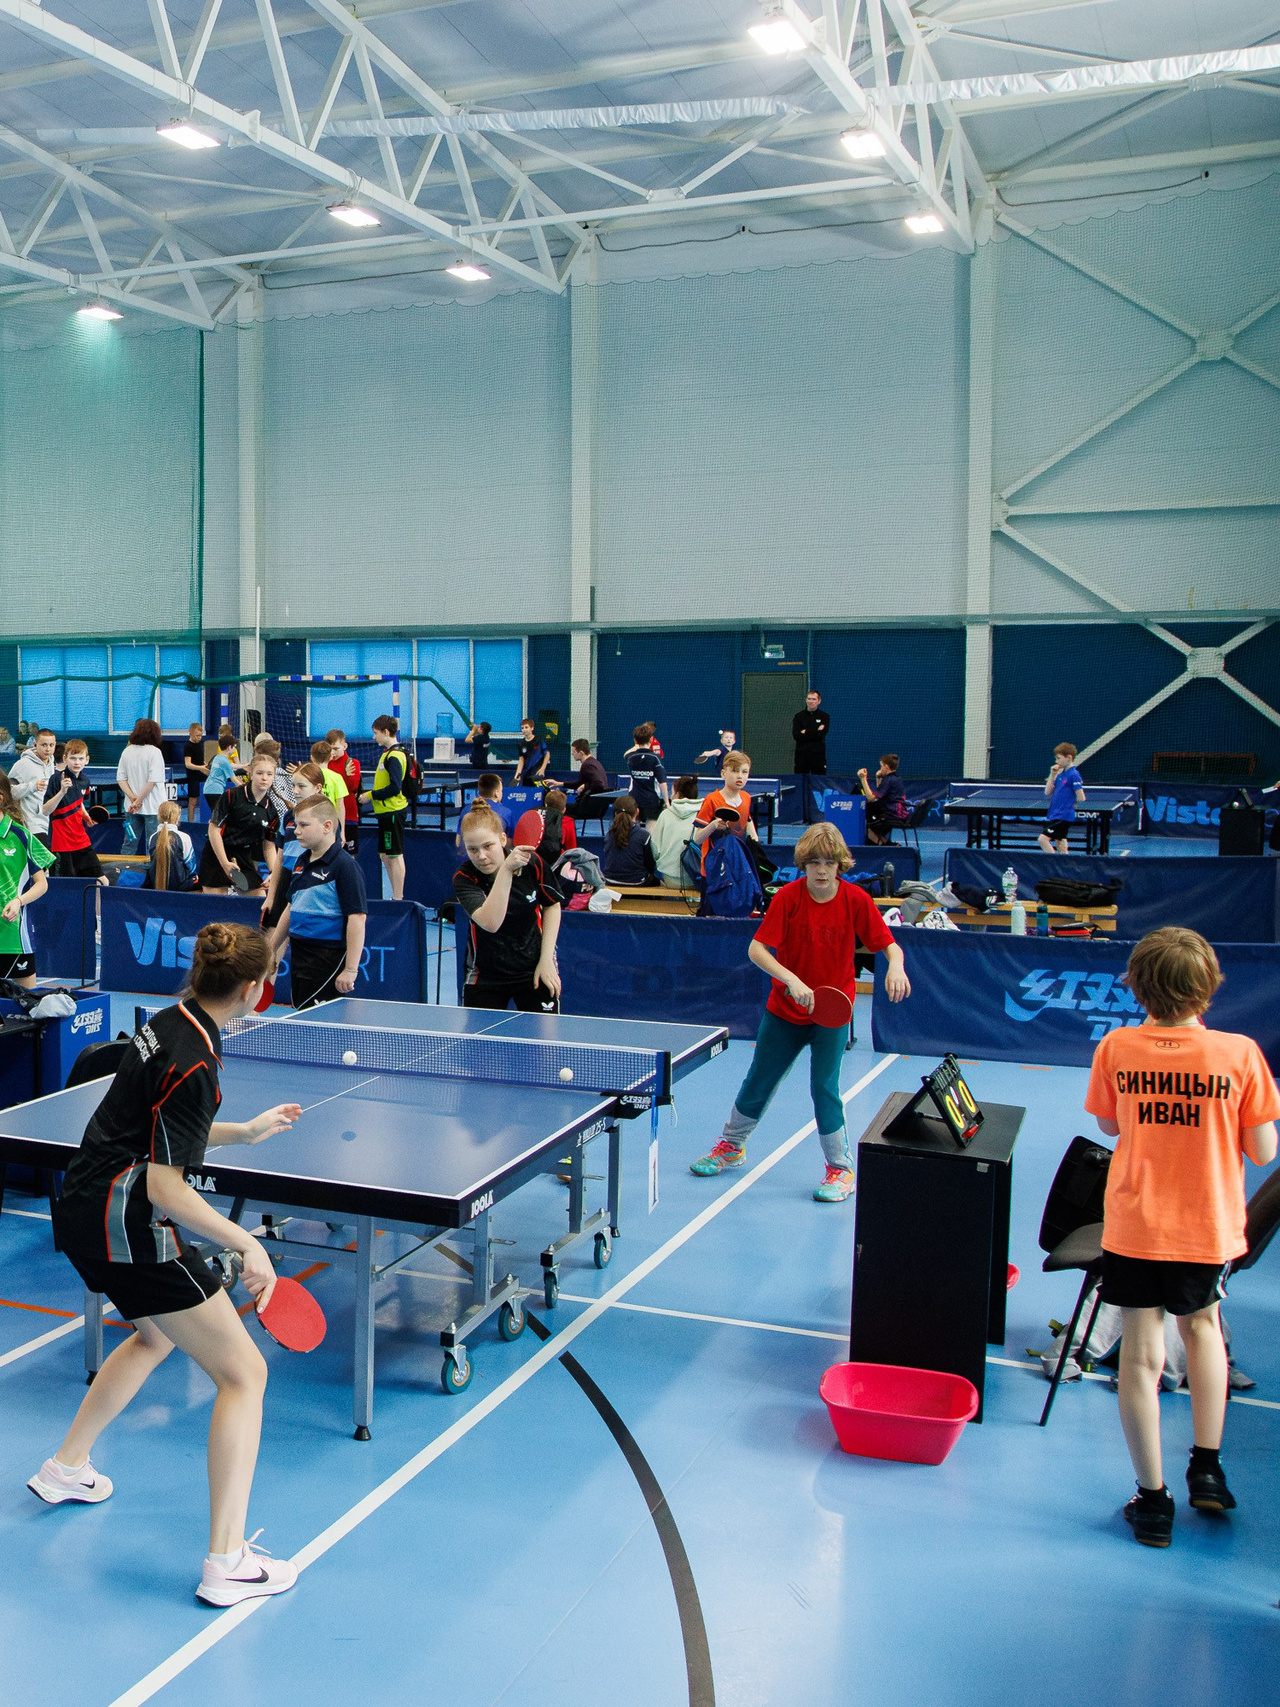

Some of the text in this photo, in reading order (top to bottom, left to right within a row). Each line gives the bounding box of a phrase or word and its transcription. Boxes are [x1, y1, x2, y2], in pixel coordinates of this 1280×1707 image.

[125, 917, 198, 968] Vis
[1116, 1071, 1231, 1100] СИНИЦЫН
[1138, 1101, 1201, 1128] ИВАН
[186, 1172, 216, 1192] OLA
[471, 1190, 494, 1219] JOOLA
